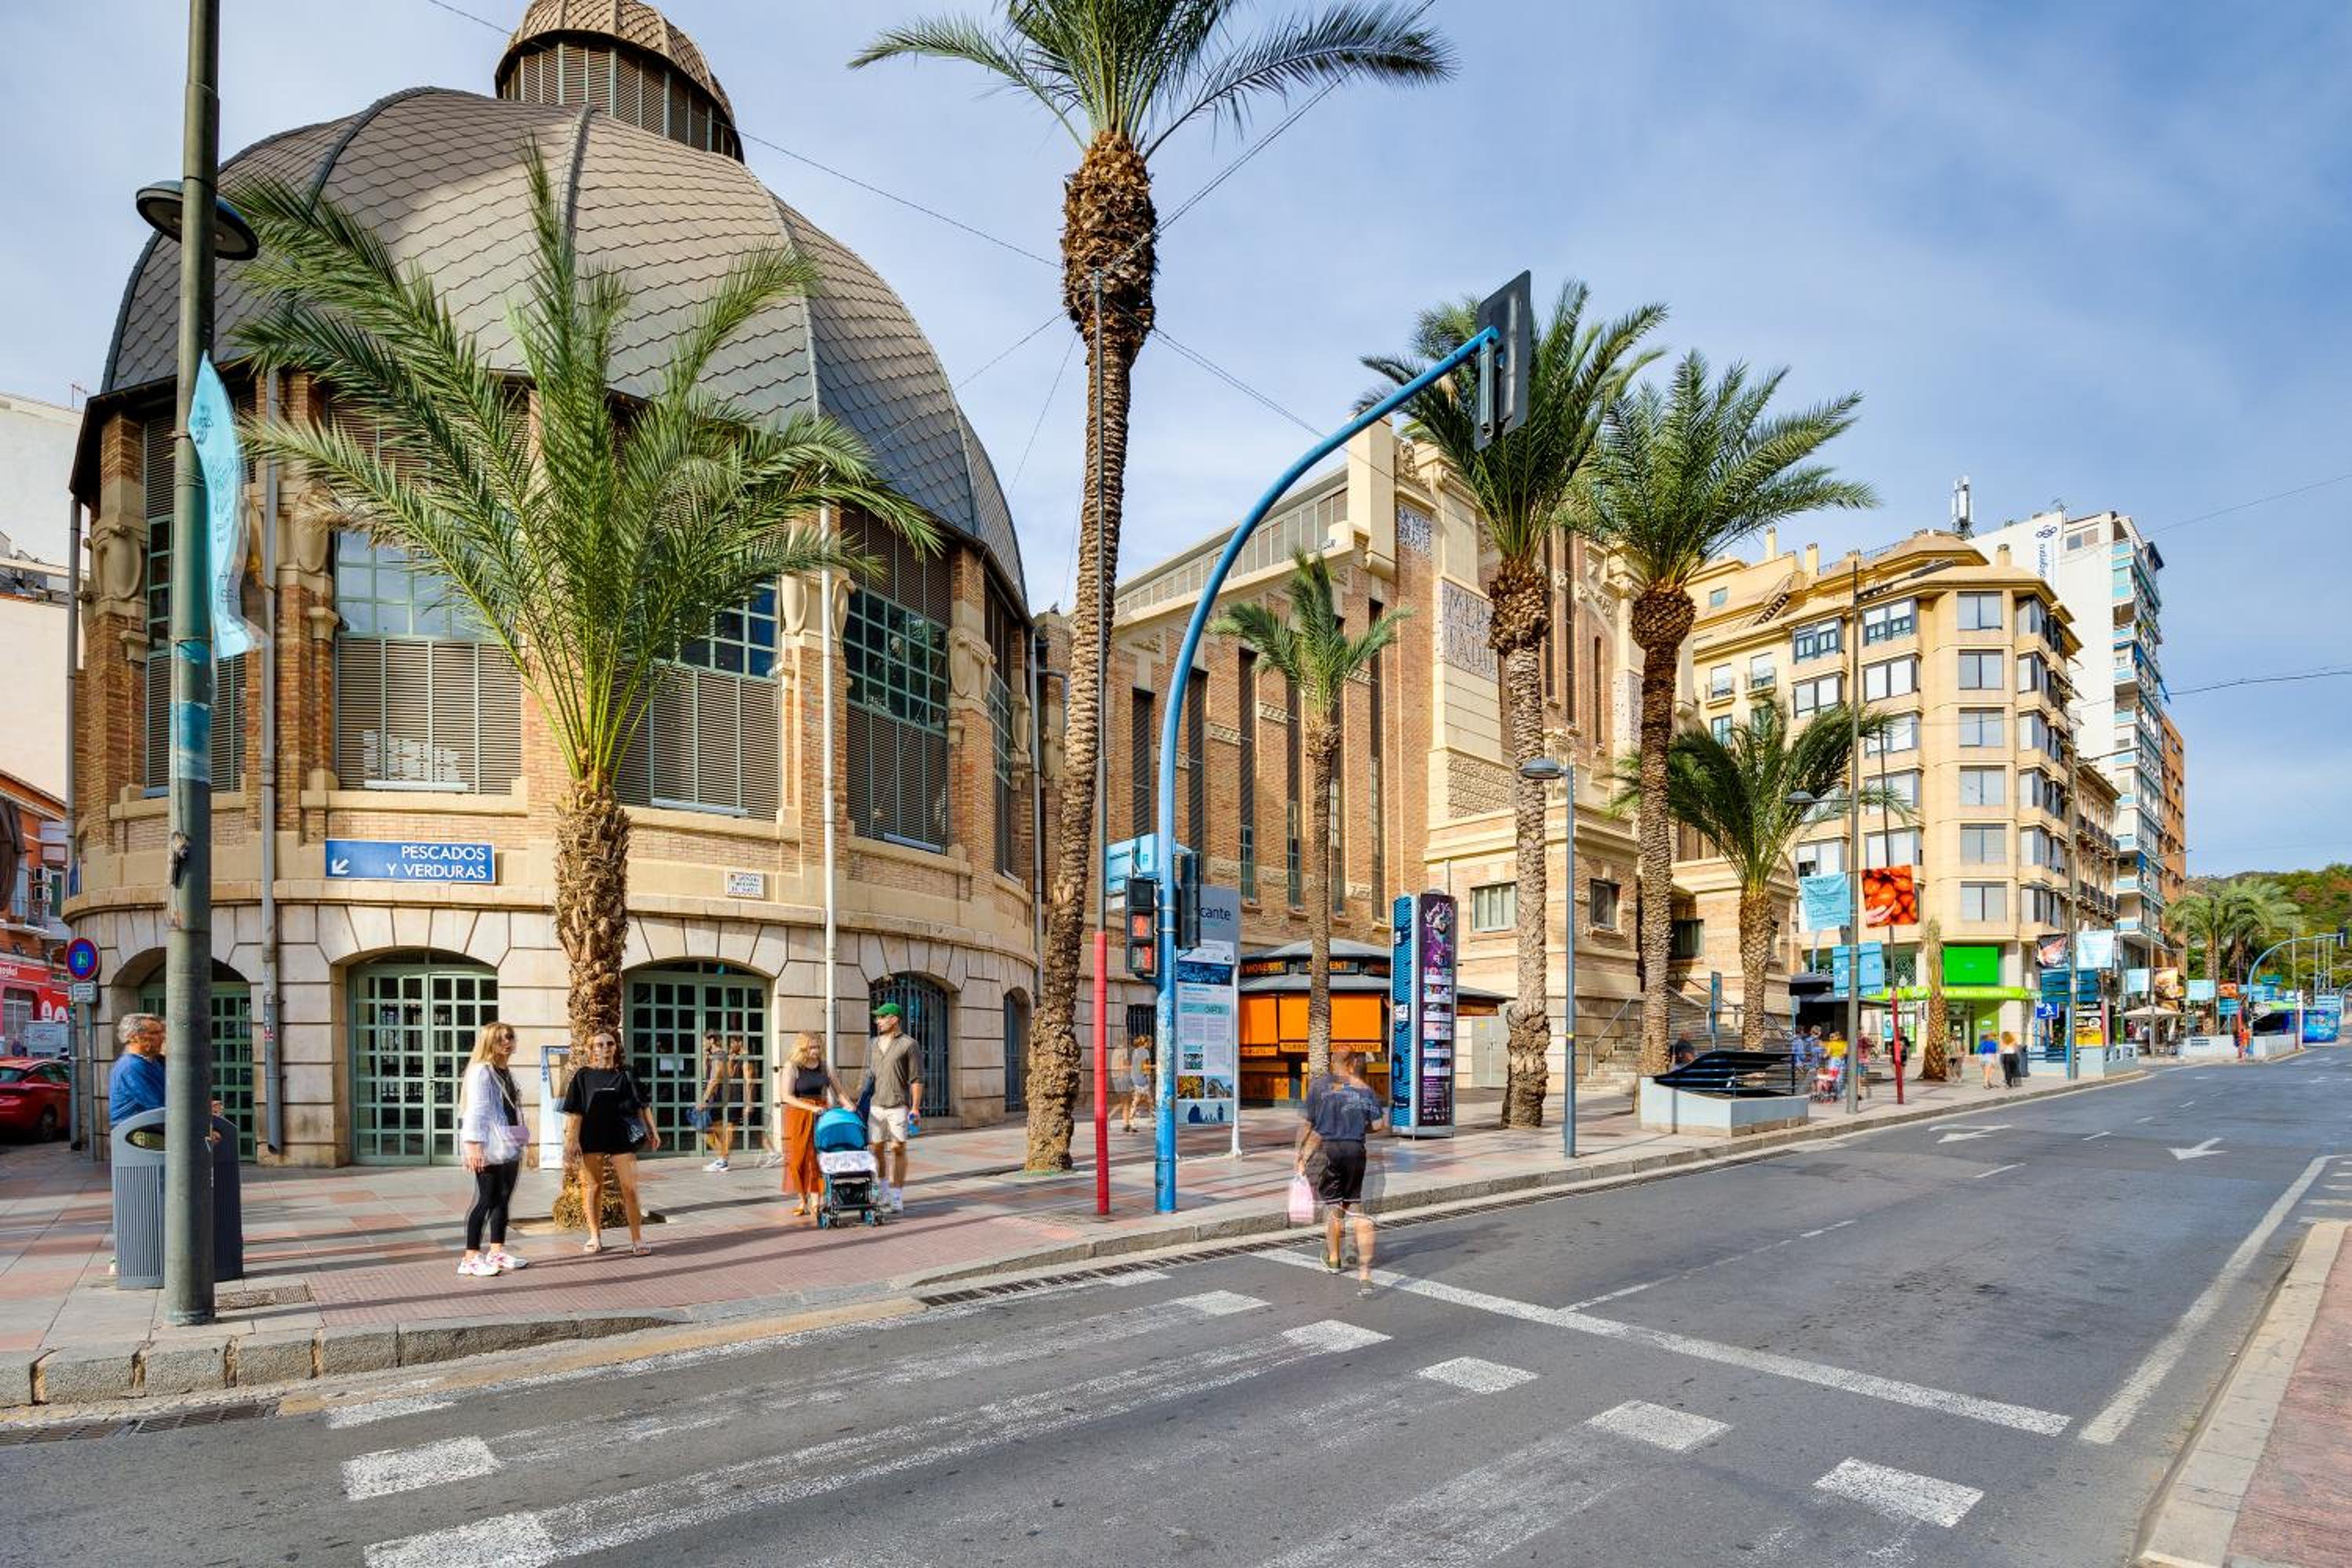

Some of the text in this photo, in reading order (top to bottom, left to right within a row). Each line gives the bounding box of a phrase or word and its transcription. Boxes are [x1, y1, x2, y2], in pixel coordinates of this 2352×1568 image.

[401, 845, 485, 860] PESCADOS
[387, 862, 486, 879] Y VERDURAS
[1200, 905, 1231, 921] cante
[1306, 961, 1347, 971] SENT
